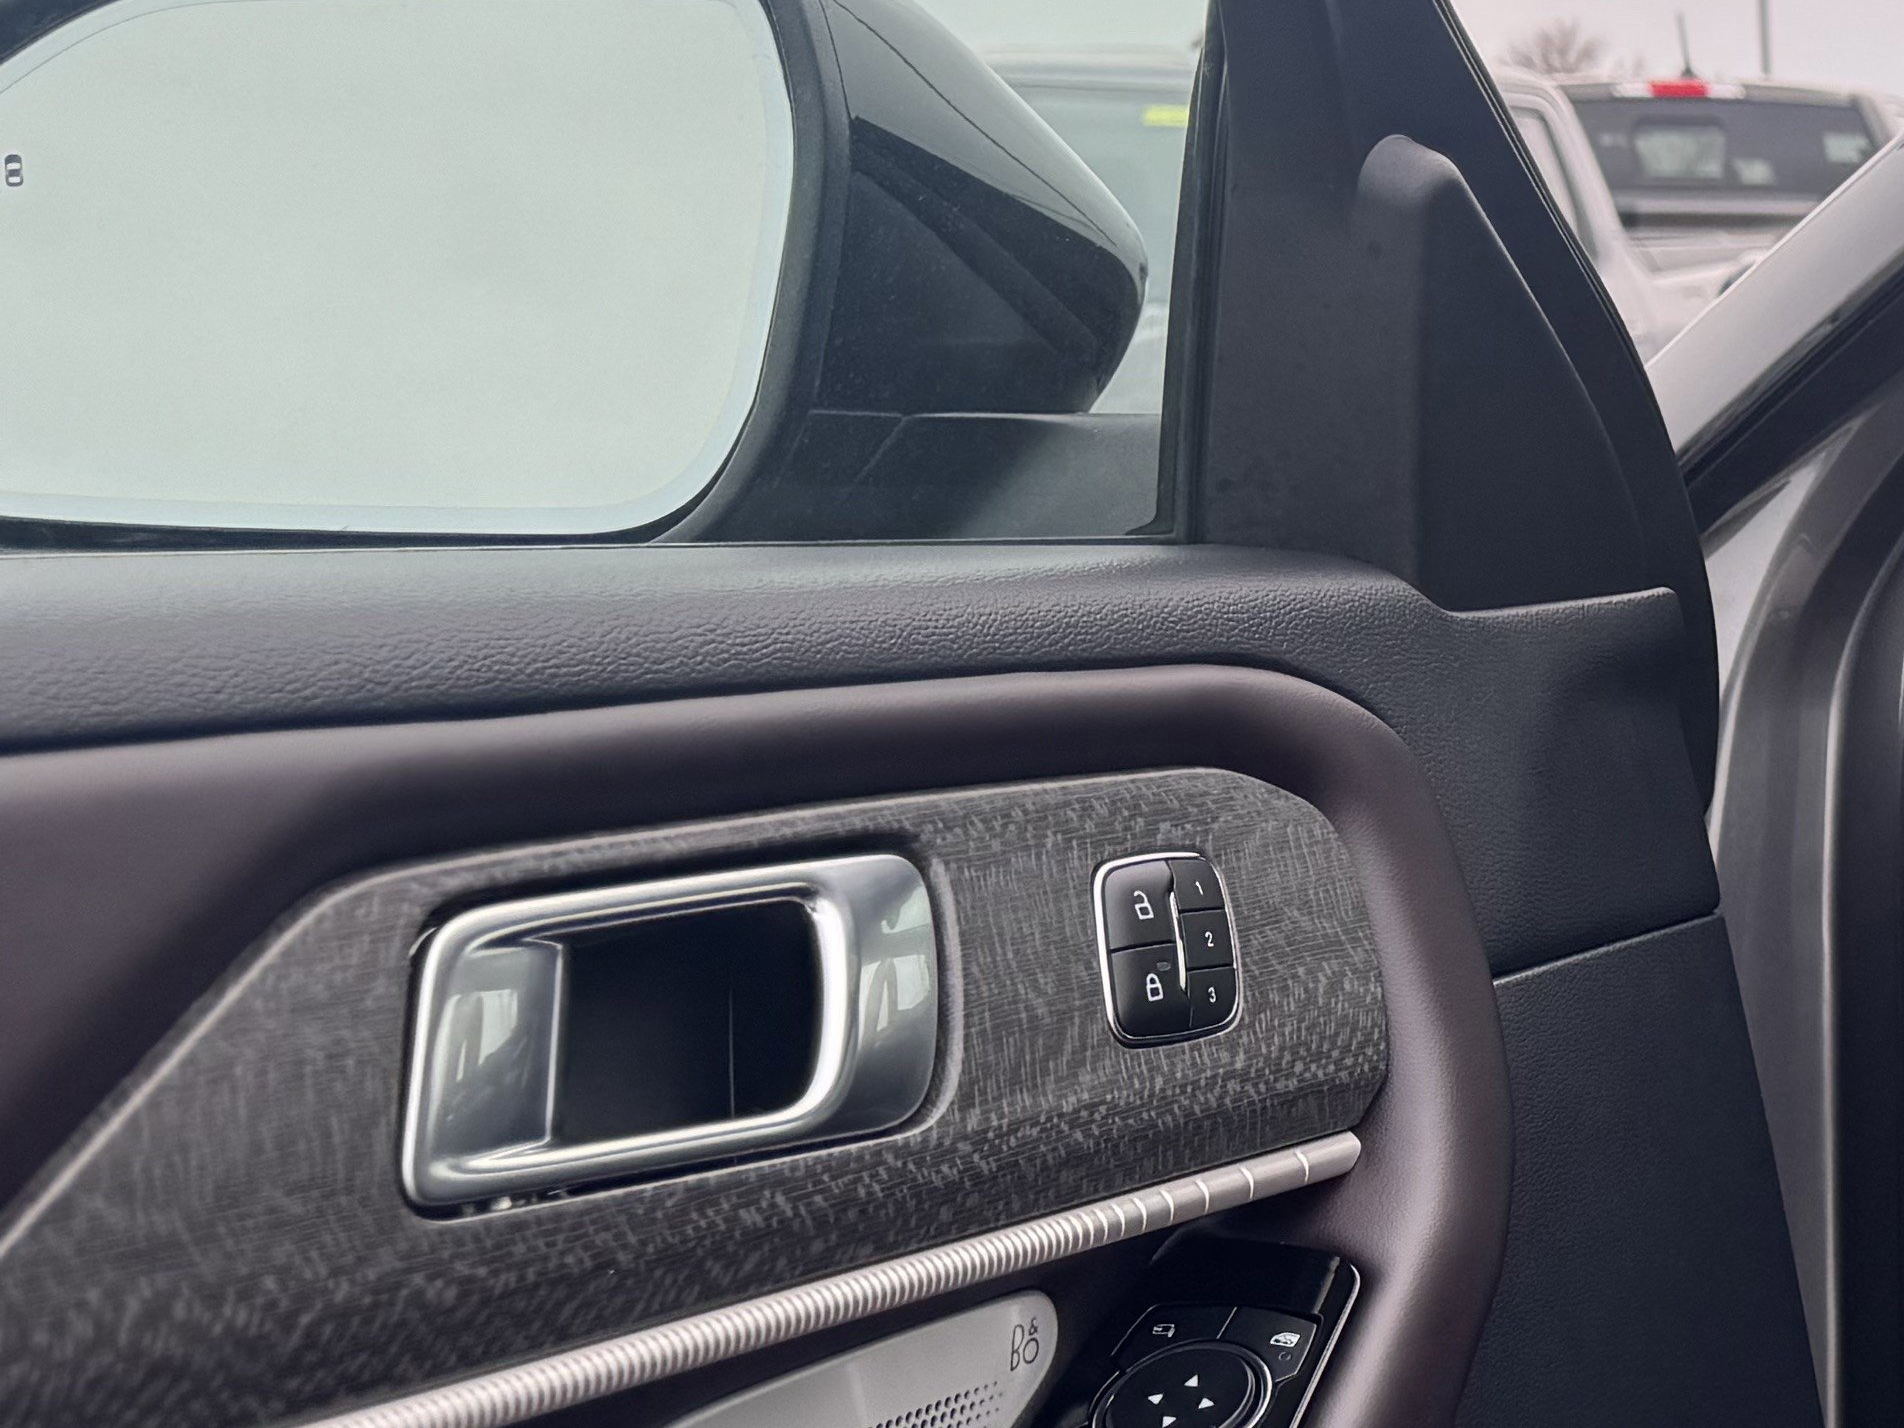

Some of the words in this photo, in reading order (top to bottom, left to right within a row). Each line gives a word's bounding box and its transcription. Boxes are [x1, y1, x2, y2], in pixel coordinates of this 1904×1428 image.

[1195, 880, 1204, 895] 1
[1204, 930, 1214, 947] 2
[1207, 986, 1217, 1003] 3
